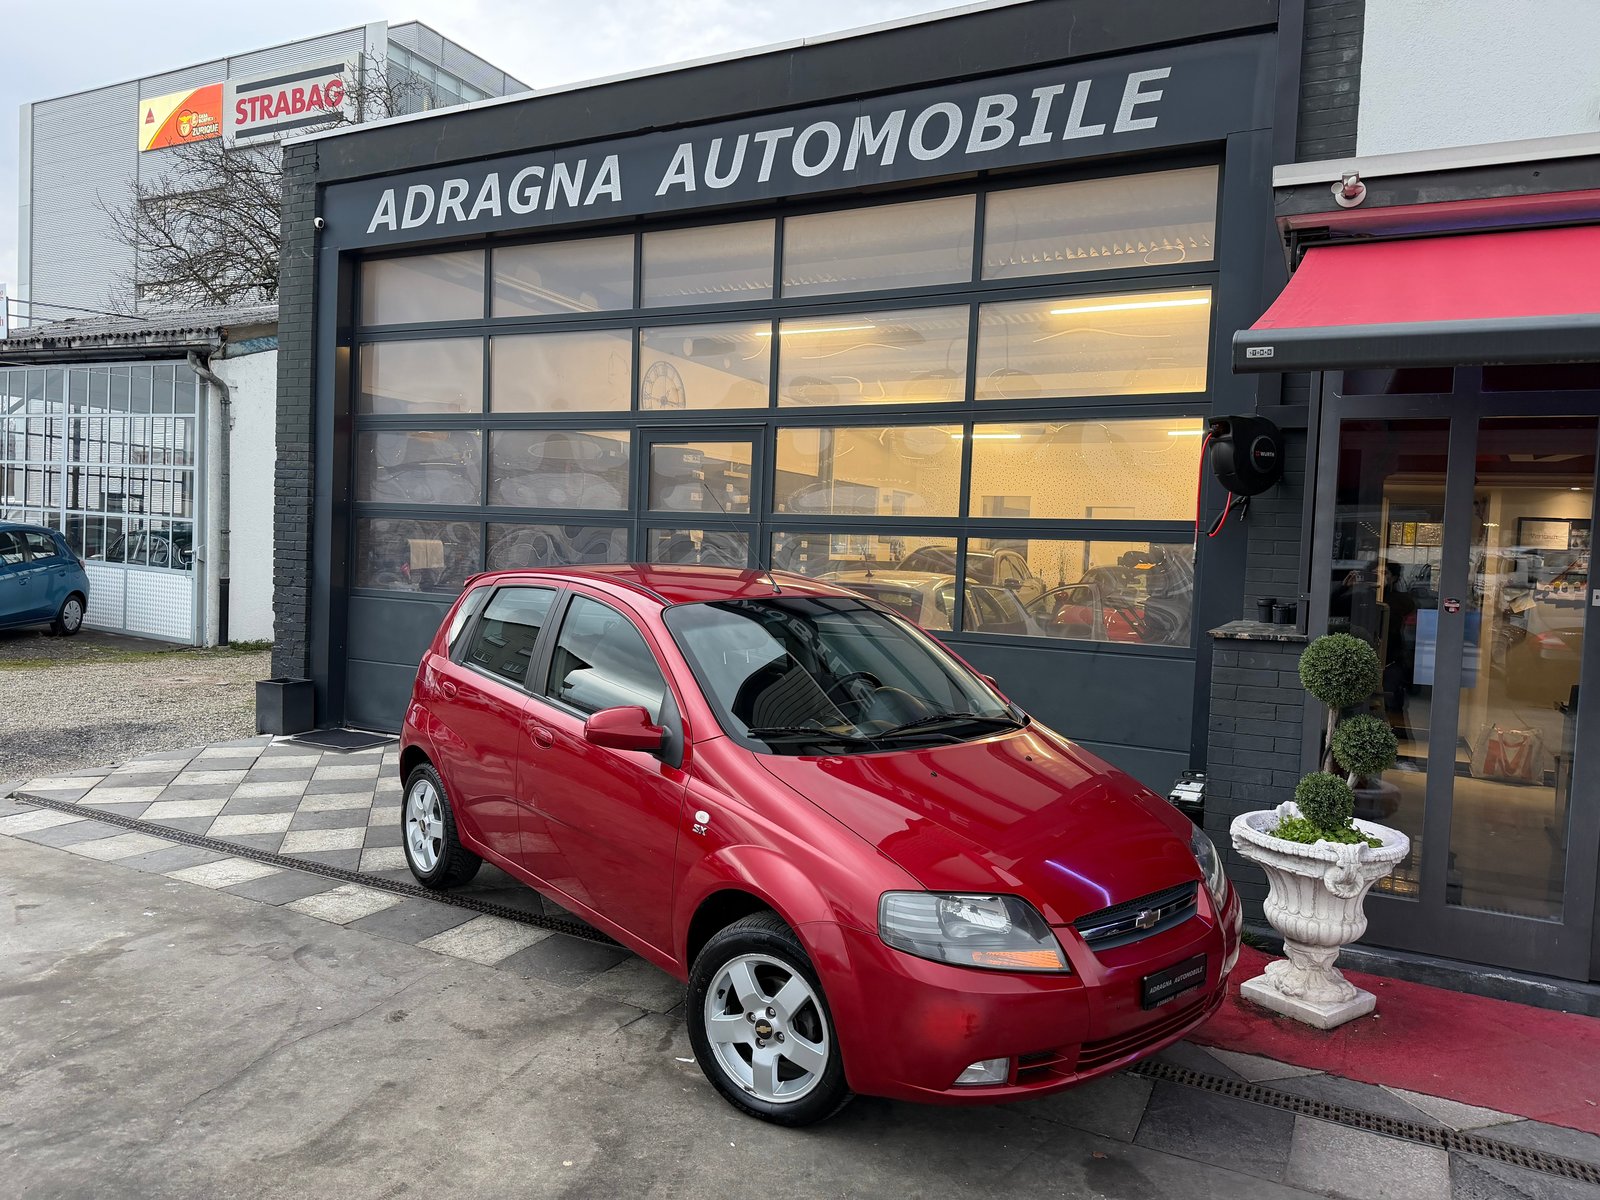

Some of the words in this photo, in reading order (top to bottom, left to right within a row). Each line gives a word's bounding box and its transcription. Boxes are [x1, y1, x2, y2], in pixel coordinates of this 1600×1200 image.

[235, 79, 344, 125] STRABAG
[192, 123, 219, 136] ZURIQUE
[367, 153, 622, 234] ADRAGNA
[655, 67, 1172, 197] AUTOMOBILE
[692, 824, 707, 836] SX
[1149, 980, 1172, 994] ADRAGNA
[1174, 966, 1204, 983] AUTOMOBILE
